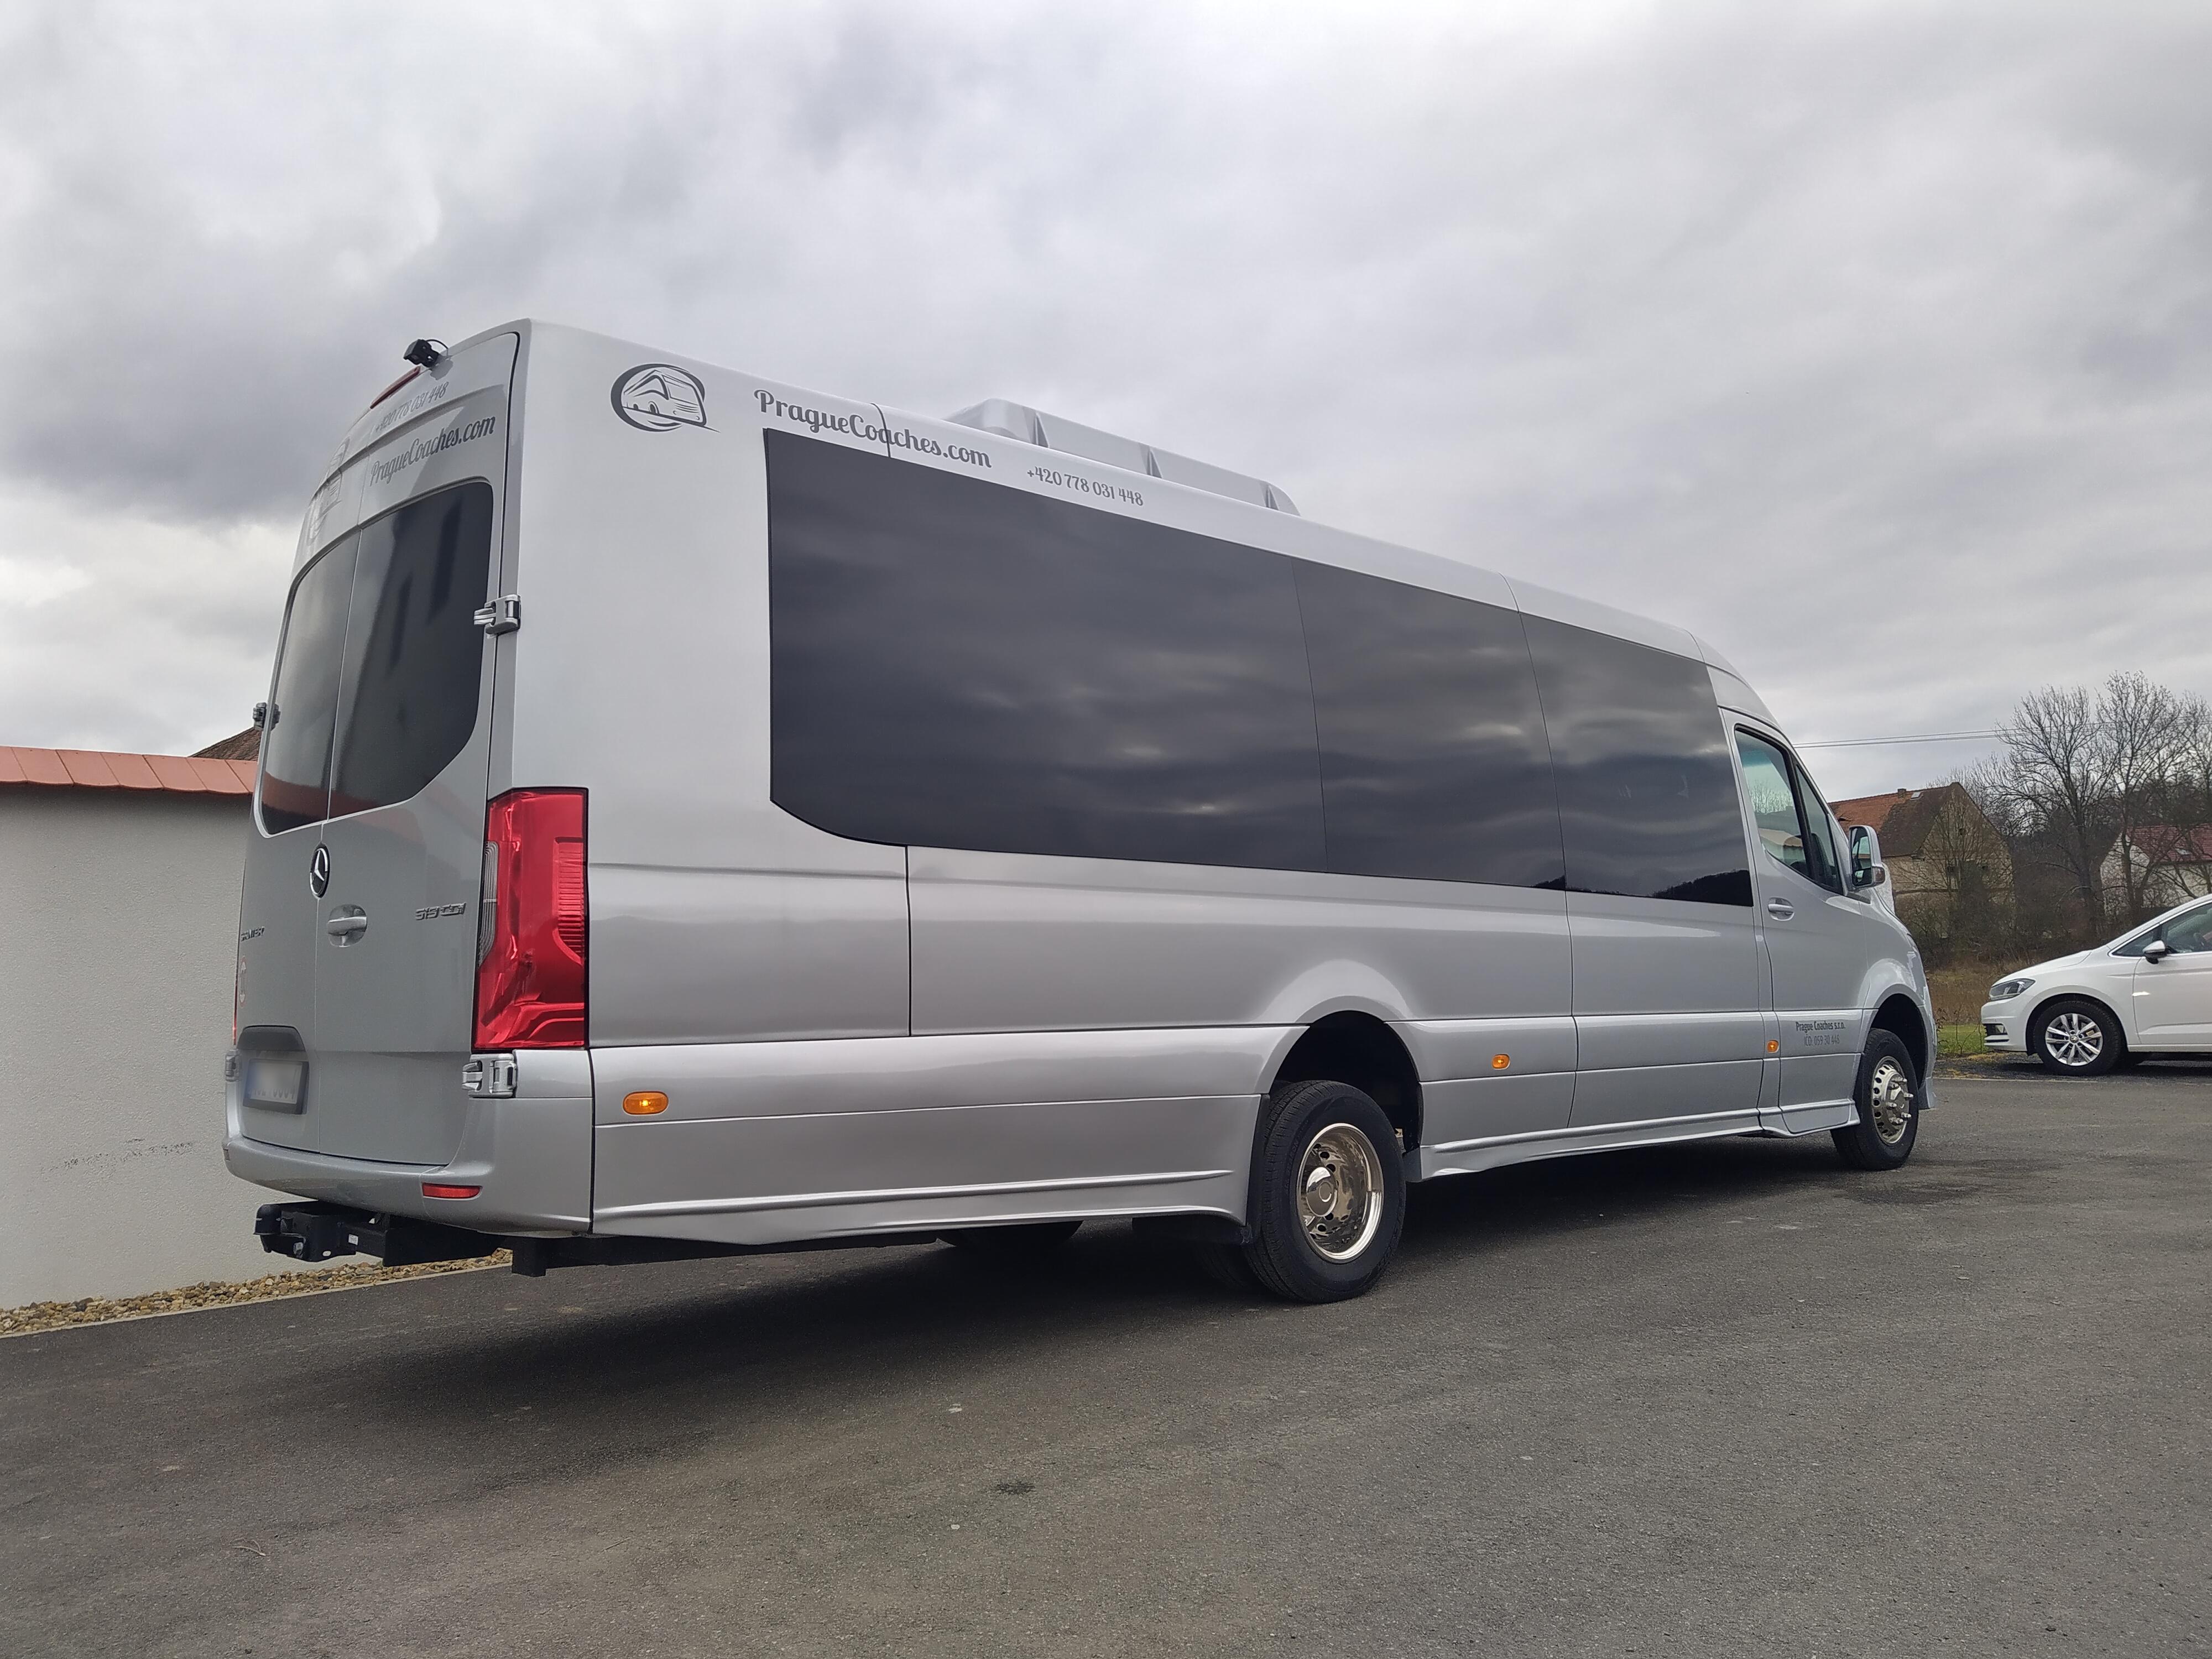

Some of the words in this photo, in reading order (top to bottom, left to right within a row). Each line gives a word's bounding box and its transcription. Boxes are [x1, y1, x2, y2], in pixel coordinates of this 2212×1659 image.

[427, 381, 449, 404] 448
[753, 389, 992, 468] PragueCoaches.com
[369, 416, 496, 487] PragueCoaches.com
[1027, 466, 1062, 486] +420
[1063, 474, 1089, 492] 778
[1092, 481, 1115, 499] 031
[1118, 487, 1144, 506] 448
[1795, 1021, 1813, 1033] Prague
[1813, 1020, 1834, 1030] Coaches
